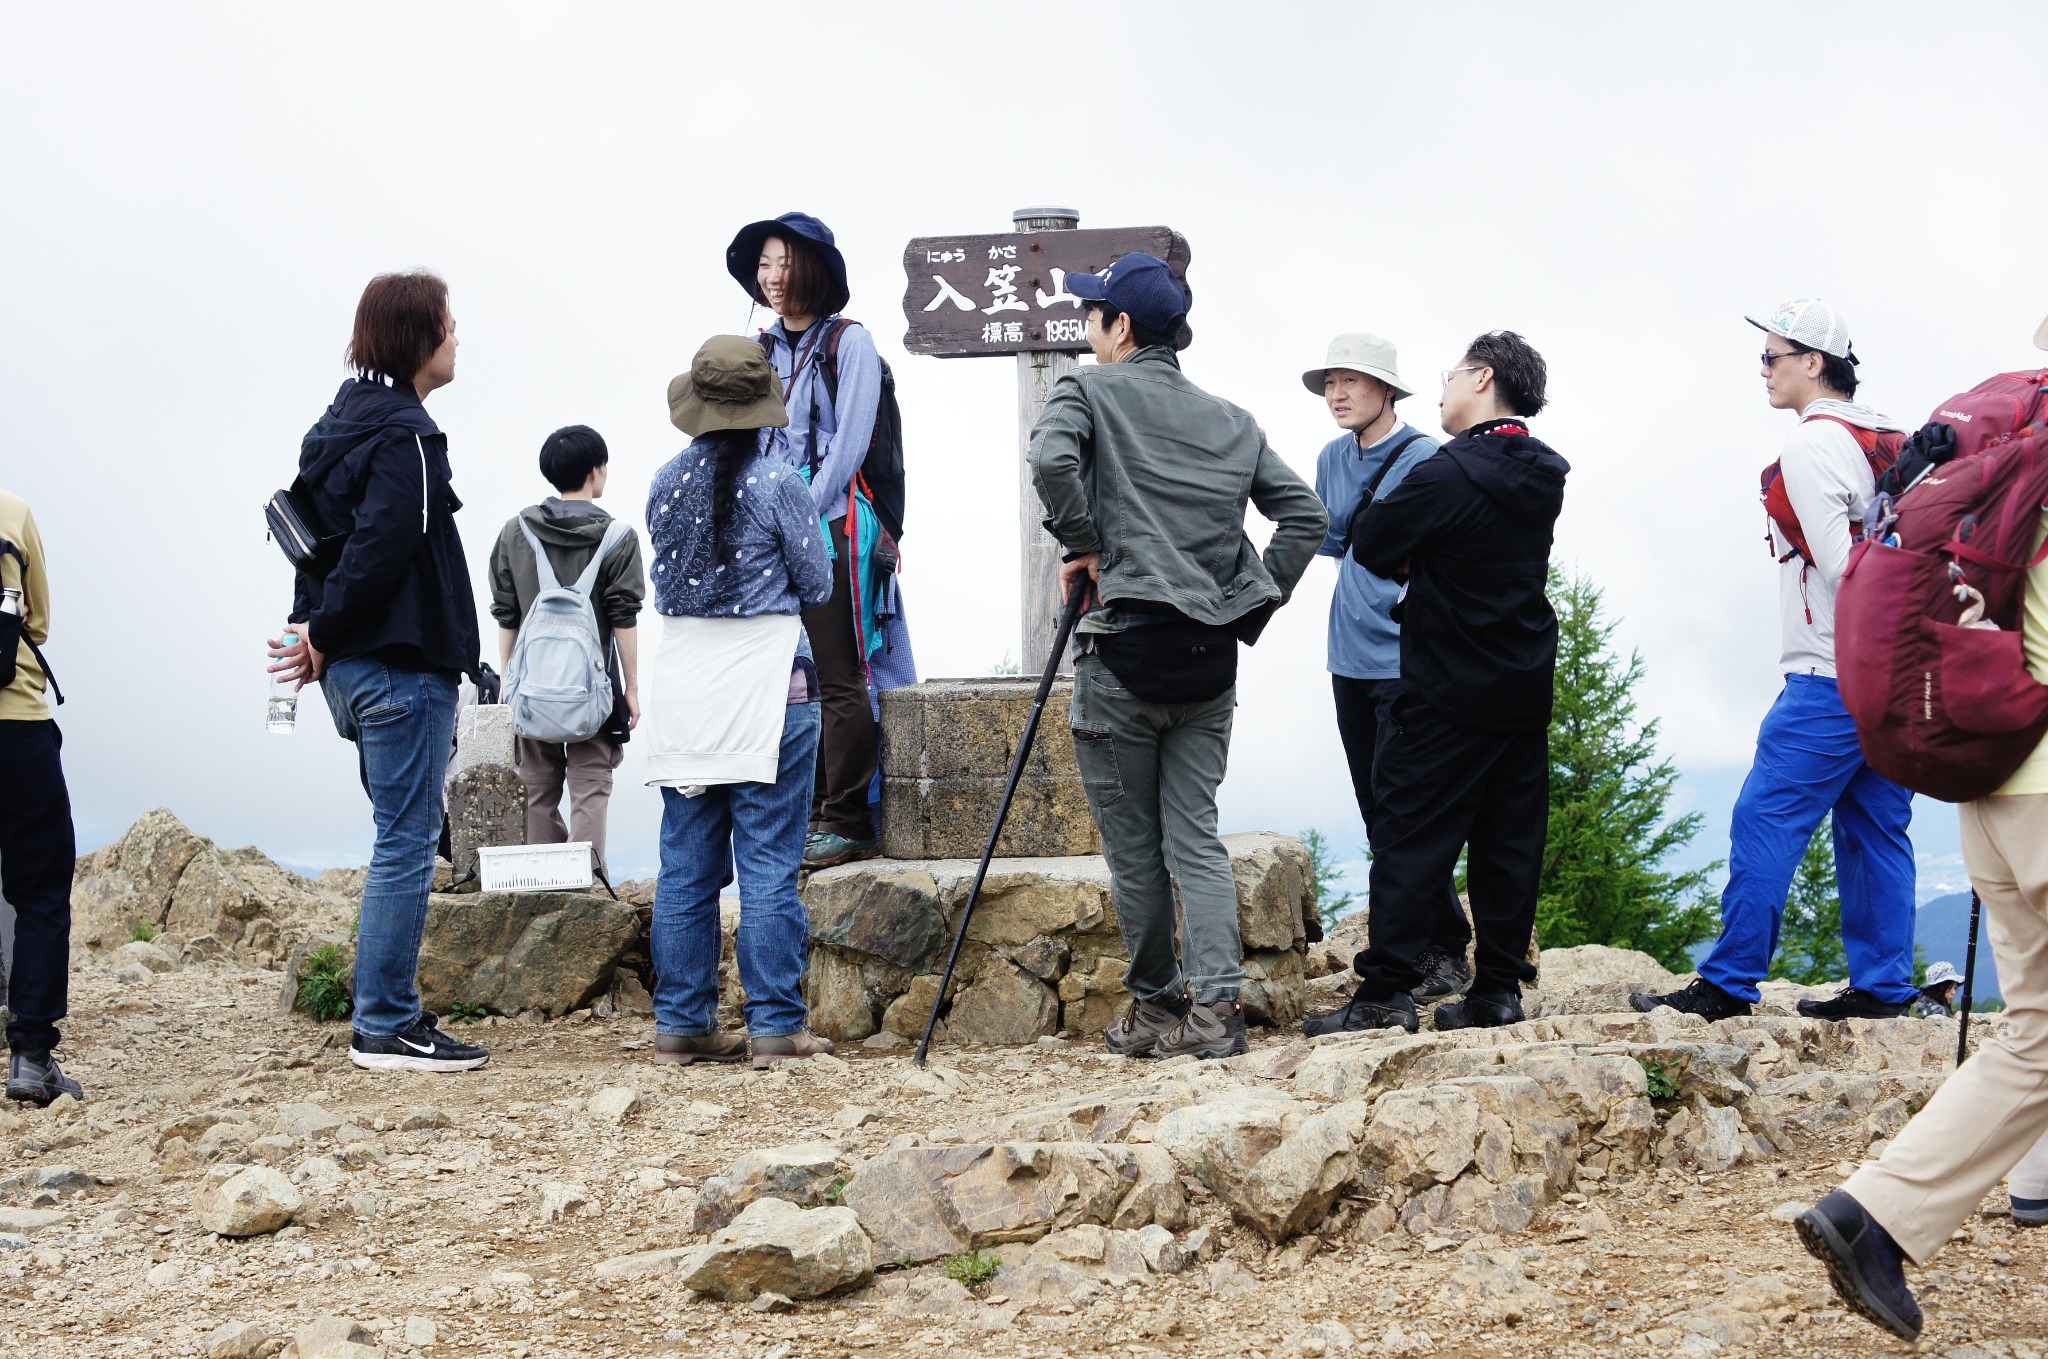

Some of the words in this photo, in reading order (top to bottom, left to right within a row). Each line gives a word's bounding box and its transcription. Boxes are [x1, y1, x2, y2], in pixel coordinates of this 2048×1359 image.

[926, 248, 966, 264] にゅう
[988, 245, 1017, 260] かさ
[923, 262, 1116, 316] 入笠山
[981, 321, 1024, 344] 標高
[1045, 319, 1088, 342] 1955M
